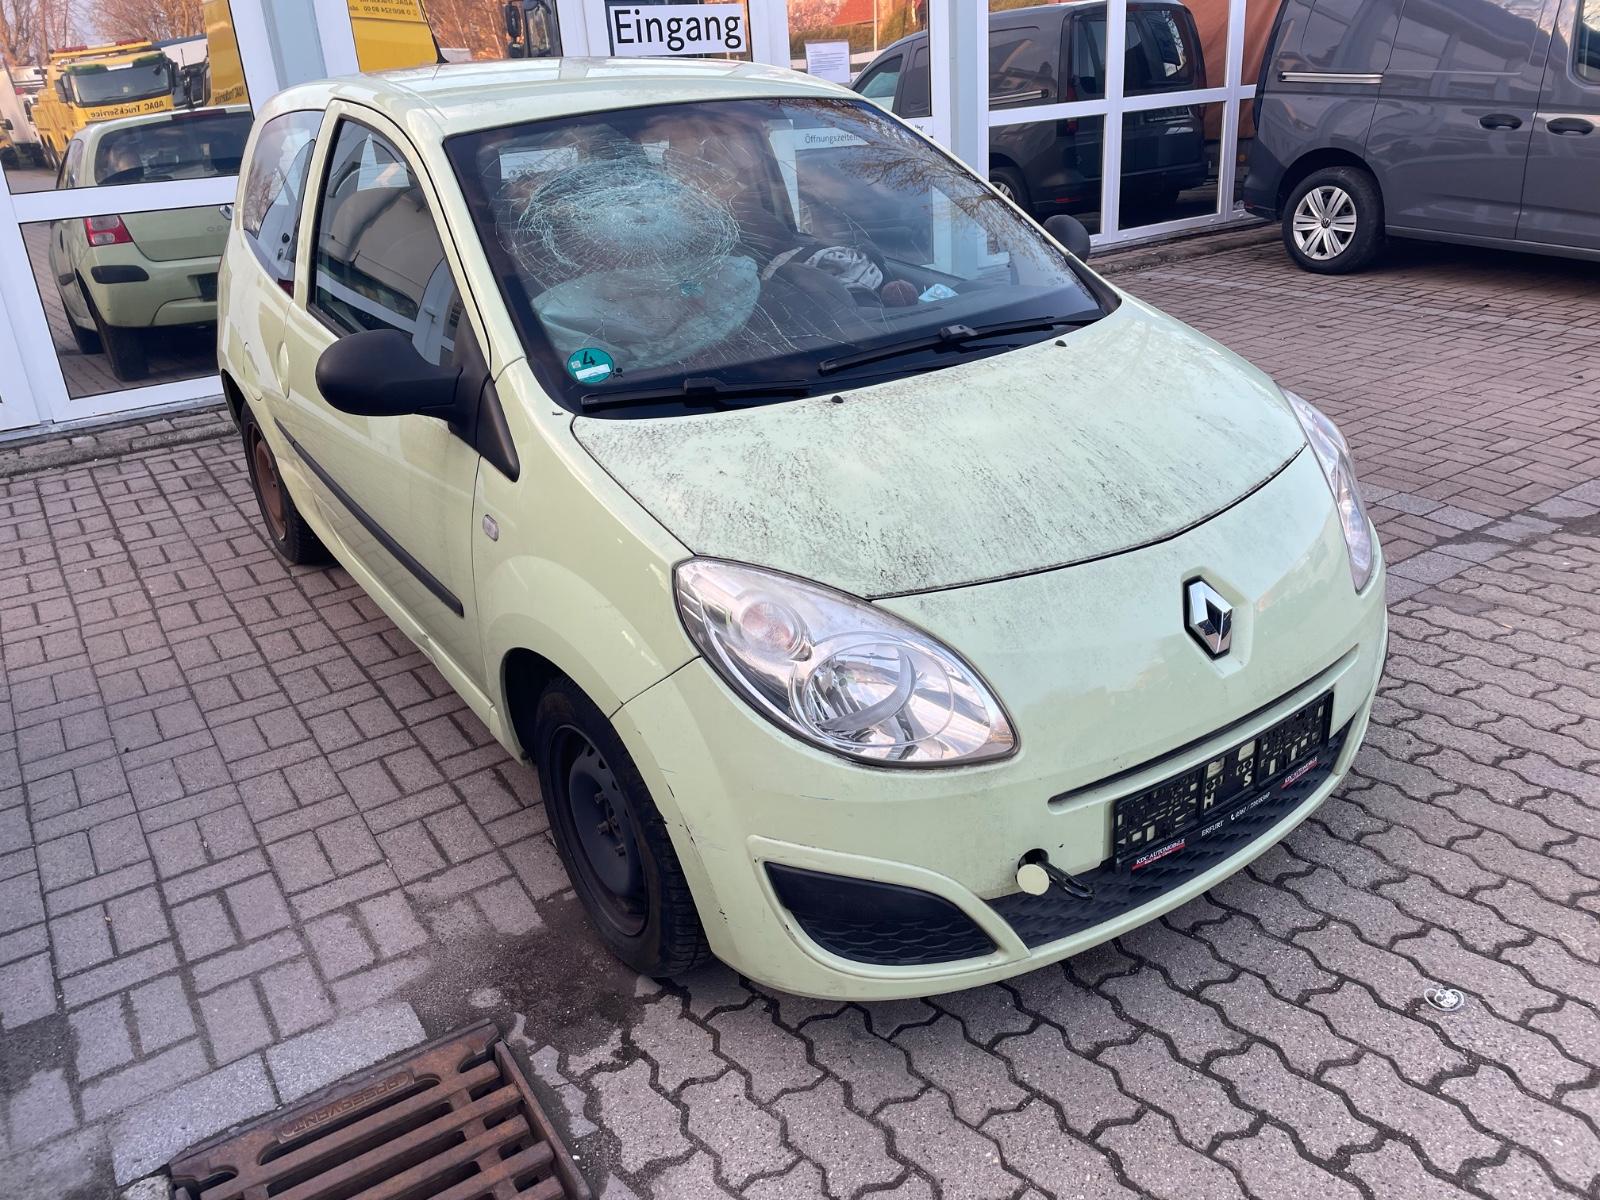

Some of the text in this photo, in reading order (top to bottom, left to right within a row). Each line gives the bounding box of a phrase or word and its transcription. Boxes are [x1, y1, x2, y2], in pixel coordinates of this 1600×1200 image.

[614, 9, 742, 52] Eingang
[583, 351, 596, 366] 4
[1201, 820, 1225, 837] ERFURT
